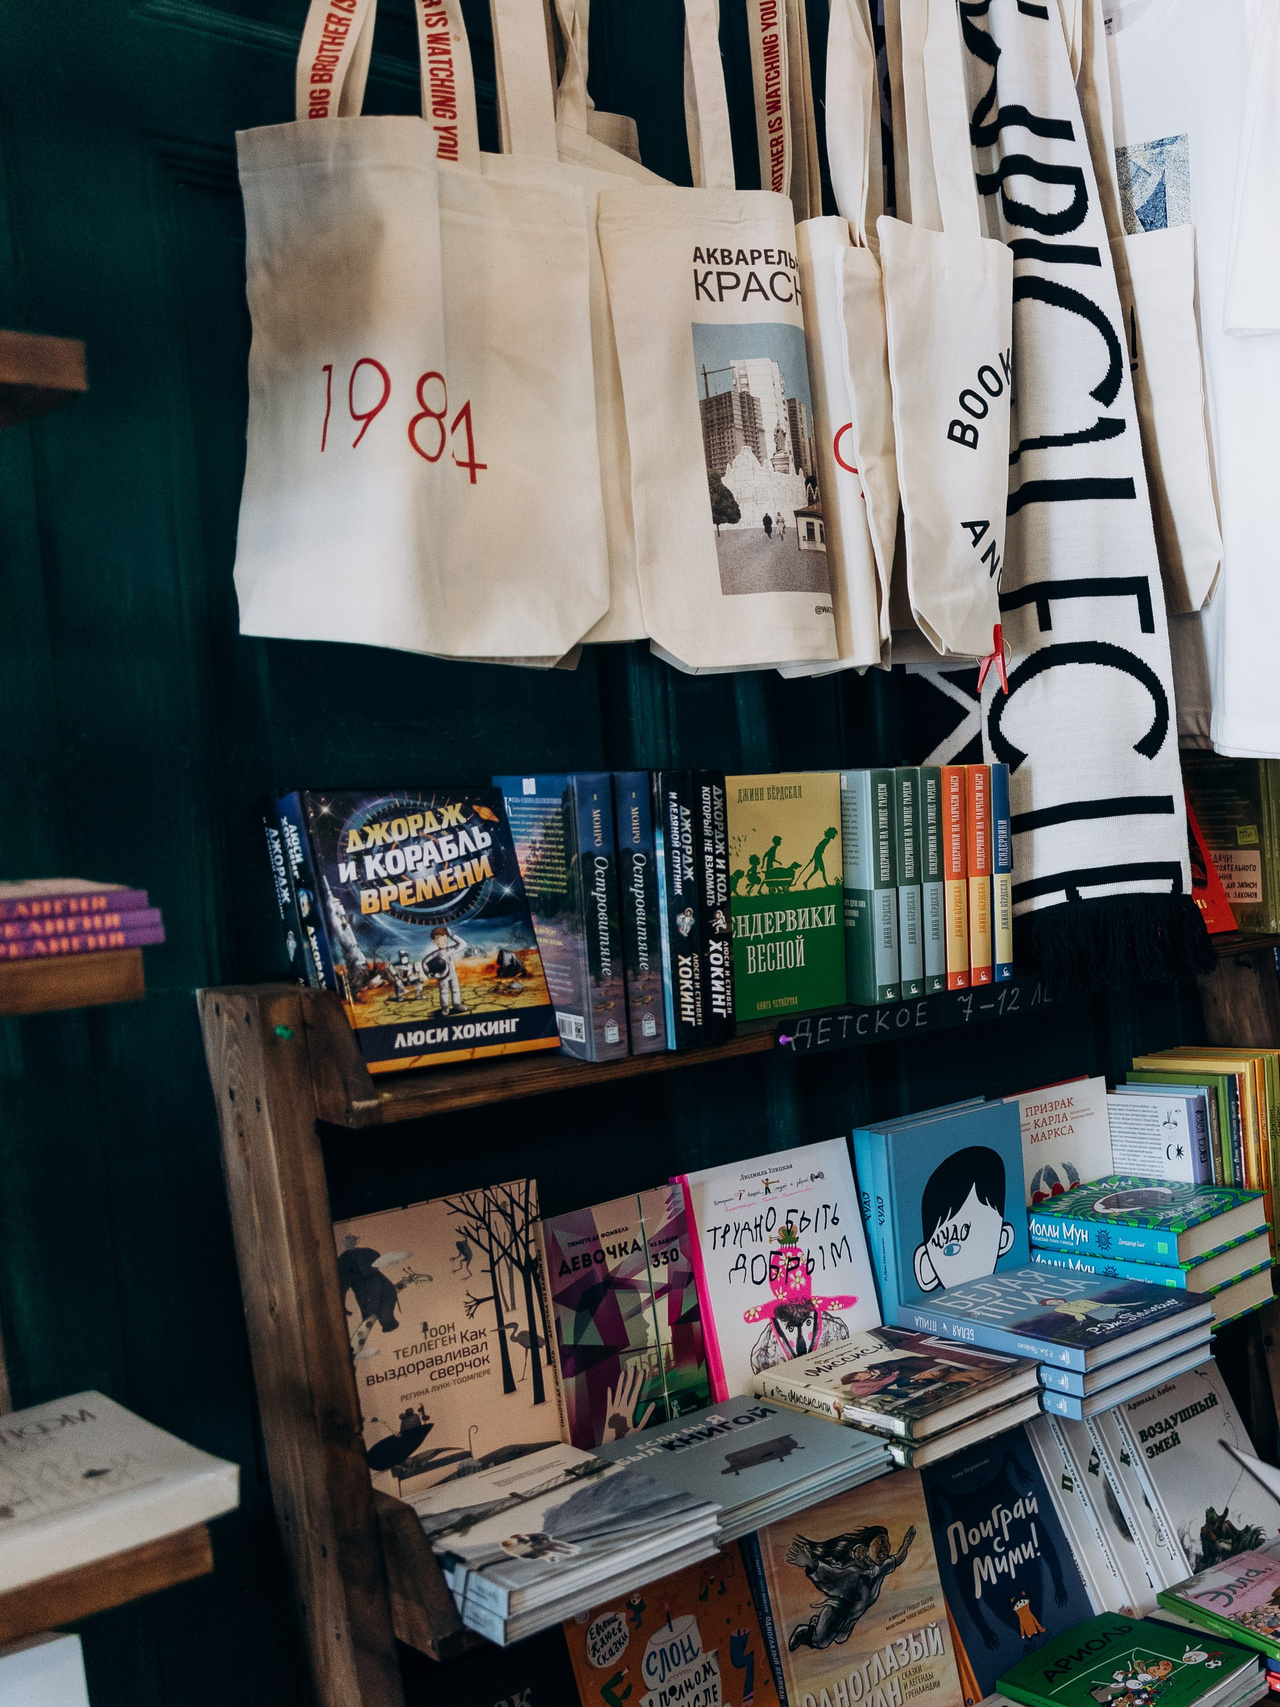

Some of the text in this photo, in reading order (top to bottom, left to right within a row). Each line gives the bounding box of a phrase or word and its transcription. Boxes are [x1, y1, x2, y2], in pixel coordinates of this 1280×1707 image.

[424, 10, 449, 28] IS
[310, 12, 352, 84] BROTHER
[426, 31, 458, 120] WATCHING
[308, 88, 331, 120] BIG
[759, 0, 785, 193] ROTHER IS WATCHING YOU
[947, 347, 1012, 449] BOOK
[321, 357, 488, 484] 1984
[960, 519, 1002, 592] AN
[701, 786, 712, 835] КОТОРЫЙ
[737, 785, 802, 803] ДЖИНН БЁРДСЕЛЛ
[346, 802, 467, 854] ДЖОРДЖ
[712, 785, 725, 855] ДЖОРДЖ
[338, 826, 492, 883] И КОРАБЛЬ
[669, 799, 683, 896] ЛЕДЯНОЙ СПУТНИК
[680, 804, 694, 881] ДЖОРДЖ
[881, 843, 891, 881] ПЕНДЕРВИКИ
[905, 841, 915, 879] ПЕНДЕРВИКИ
[929, 838, 939, 876] ПЕНДЕРВИКИ
[952, 836, 961, 873] ПЕНДЕРВИКИ
[976, 833, 986, 870] ПЕНДЕРВИКИ
[998, 820, 1008, 867] ПЕНДЕРВИКИ
[268, 827, 291, 904] ДЖОРДЖ
[359, 855, 494, 915] ВРЕМЕНИ
[705, 854, 715, 906] ВЗЛОМАТЬ
[1237, 881, 1258, 889] ЗАПИСИ
[591, 809, 612, 976] МОНРО Островитяне
[632, 806, 650, 971] МОНРО Островитяне
[1234, 891, 1258, 899] ЗАКОНОВ
[732, 904, 837, 943] НДЕРВИКИ
[747, 936, 806, 975] ВЕСНОЙ
[678, 954, 695, 1027] ХОКИНГ
[709, 940, 728, 1018] ХОКИНГ
[395, 1018, 520, 1048] ЛЮСИ ХОКИНГ
[791, 1001, 928, 1051] ДЕТСКОЕ
[1025, 1097, 1075, 1118] ПРИЗРАК
[1033, 1112, 1069, 1130] КАРЛА
[1030, 1124, 1075, 1145] МАРКСА
[707, 1206, 777, 1250] ТРУДНО
[785, 1203, 840, 1234] БЫТЬ
[876, 1195, 886, 1226] ЧУДО
[600, 1226, 629, 1239] ФОМБЕЛЬ
[931, 1220, 972, 1248] ЧУДО
[1062, 1222, 1089, 1245] Мун
[558, 1238, 643, 1277] ДЕВОЧКА
[651, 1248, 680, 1268] 330
[728, 1235, 852, 1285] ДОБРЫМ
[930, 1269, 1058, 1309] БЕЛАЯ
[972, 1277, 1100, 1319] ПТИЦА
[393, 1327, 487, 1361] ТЕЛЛЕГЕН Как
[422, 1322, 457, 1341] ТООН
[915, 1315, 975, 1341] БЕЛАЯ ПТИЦА
[366, 1341, 489, 1387] выздоравливал
[429, 1354, 491, 1381] сверчок
[400, 1385, 430, 1402] РЕГИНА
[1127, 1384, 1177, 1411] Арнольд Лобел
[613, 1447, 664, 1466] БЫЛ
[660, 1405, 778, 1452] КНИГОЙ
[635, 1414, 727, 1450] ЕСЛИ БЫ Я
[1138, 1391, 1219, 1443] ВОЗДУШНЫЙ
[1145, 1430, 1182, 1460] ЗМЕЙ
[946, 1491, 1040, 1565] Поиграй
[993, 1536, 1006, 1553] с
[973, 1522, 1042, 1599] Мими!
[645, 1634, 700, 1684] СЛОН
[765, 1616, 786, 1701] ОДНОГЛАЗЫЙ ВЕЛИКАН
[802, 1622, 946, 1707] ОДНОГЛАЗЫЙ
[901, 1664, 922, 1681] СКАЗКИ
[1041, 1622, 1133, 1684] АРИОЛЬ
[905, 1680, 942, 1701] ГРЕНЛАНДИИ
[908, 1671, 934, 1688] ЛЕГЕНДЫ
